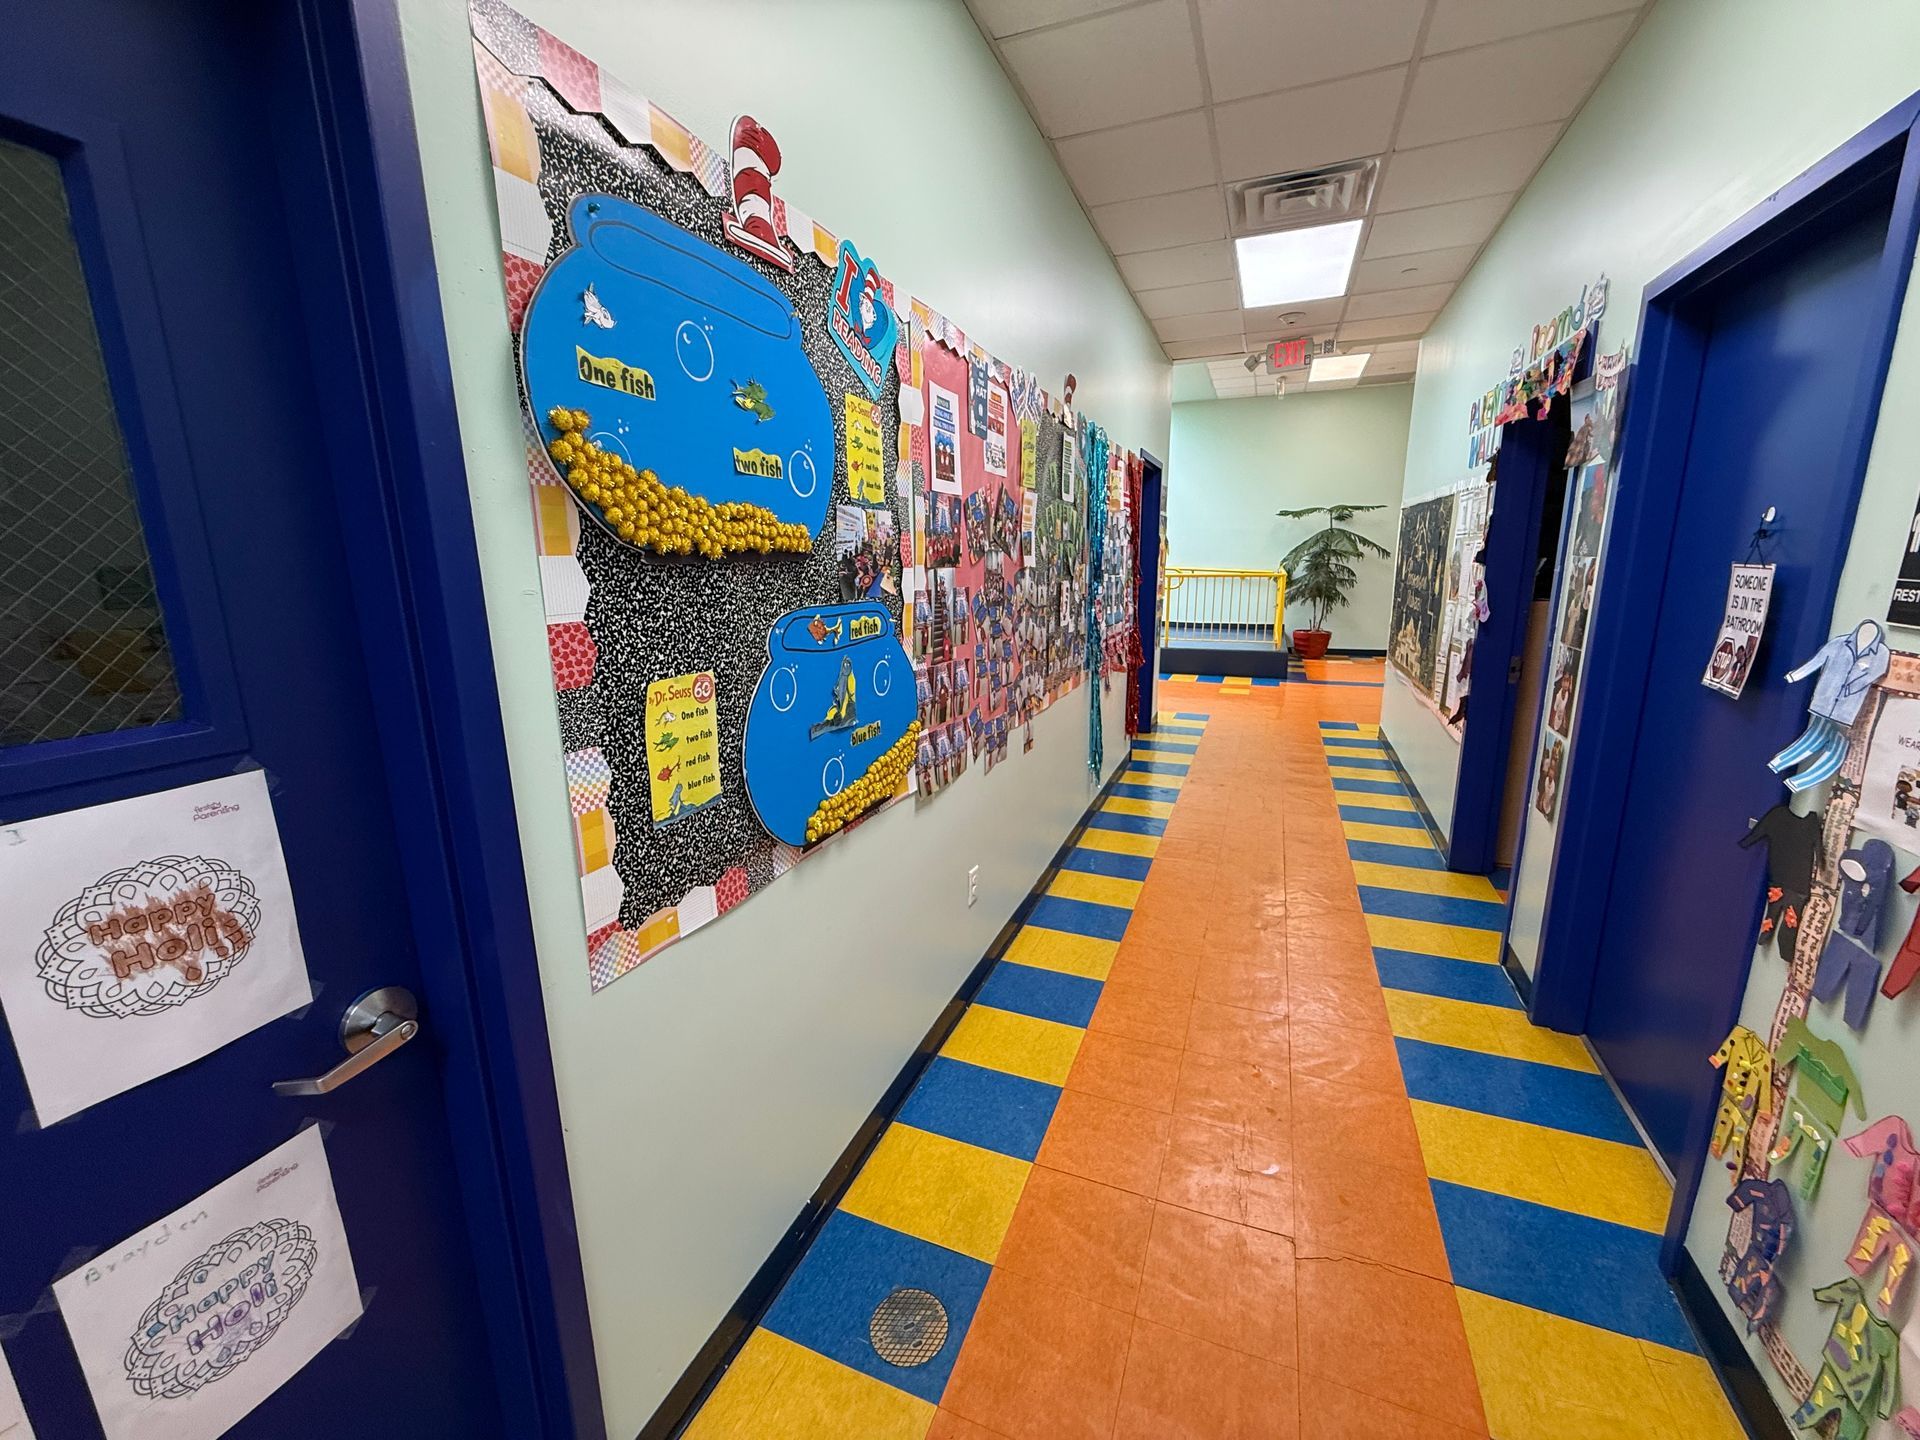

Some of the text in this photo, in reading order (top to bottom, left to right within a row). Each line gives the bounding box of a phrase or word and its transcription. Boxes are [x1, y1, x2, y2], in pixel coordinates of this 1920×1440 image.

[832, 311, 882, 384] READING
[1274, 340, 1308, 368] EXIT
[579, 355, 655, 399] One fish
[735, 452, 782, 477] two fish
[1735, 574, 1768, 591] SOMEONE
[1731, 595, 1763, 613] IS IN THE
[851, 622, 878, 637] red fish
[1726, 615, 1762, 635] BATHROOM
[1714, 651, 1731, 669] STOP
[654, 691, 667, 706] Dr.
[668, 685, 691, 701] Seuss
[694, 681, 711, 698] 60
[681, 706, 708, 720] One fish
[686, 729, 712, 744] two fish
[852, 725, 881, 745] blue fish
[686, 752, 710, 767] red fish
[688, 774, 715, 790] blue fish
[193, 804, 240, 822] Parenting
[89, 892, 216, 946] Happy
[111, 917, 220, 979] Holi
[84, 1210, 208, 1286] Brayden
[168, 1251, 276, 1334] Happy
